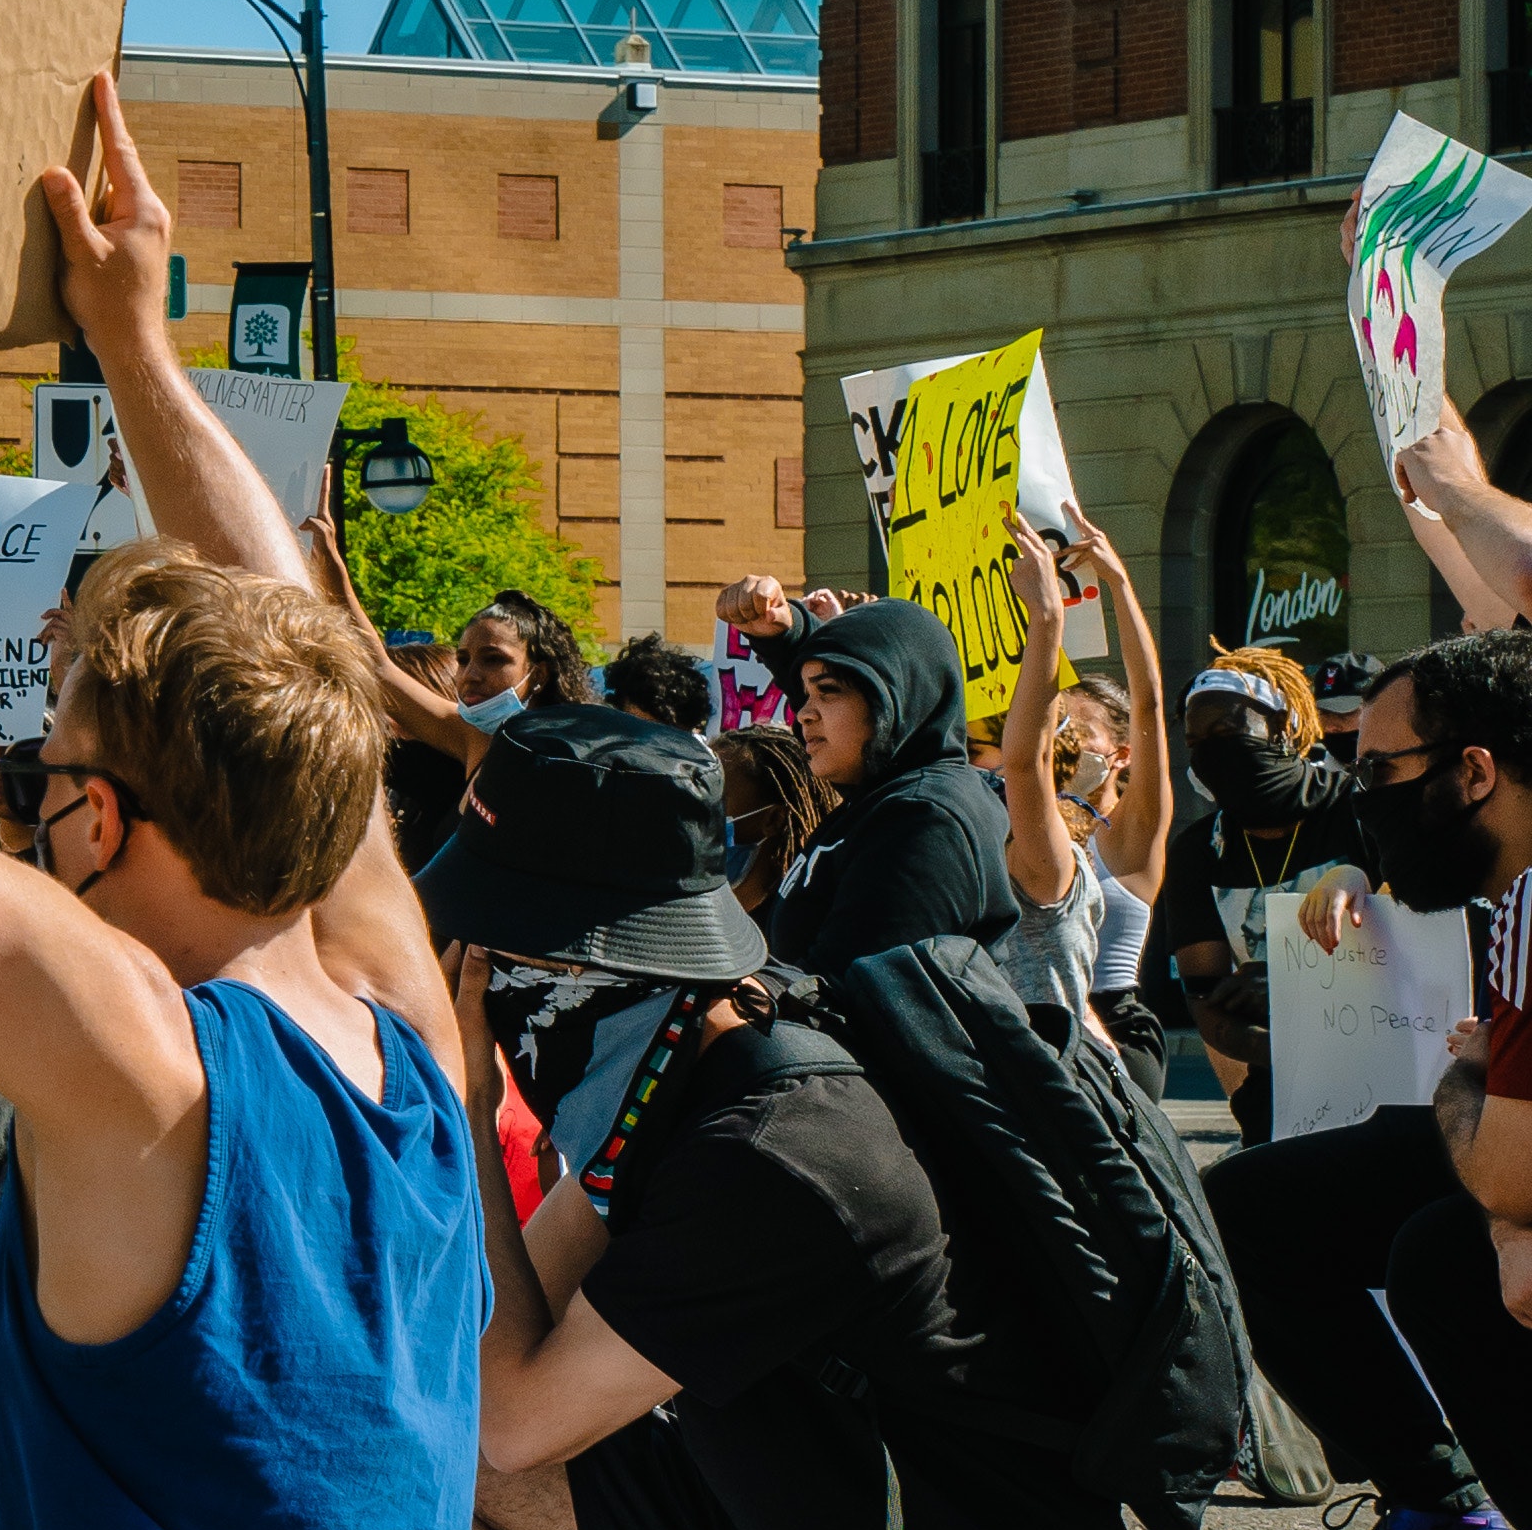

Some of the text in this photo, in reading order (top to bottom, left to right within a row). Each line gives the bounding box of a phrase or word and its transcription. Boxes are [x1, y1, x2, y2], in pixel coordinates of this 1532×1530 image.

[188, 371, 315, 423] KLIVESMATTER
[938, 375, 1028, 509] LOVE
[1246, 567, 1343, 647] London
[1284, 936, 1318, 972] NO
[1324, 1004, 1358, 1036] NO
